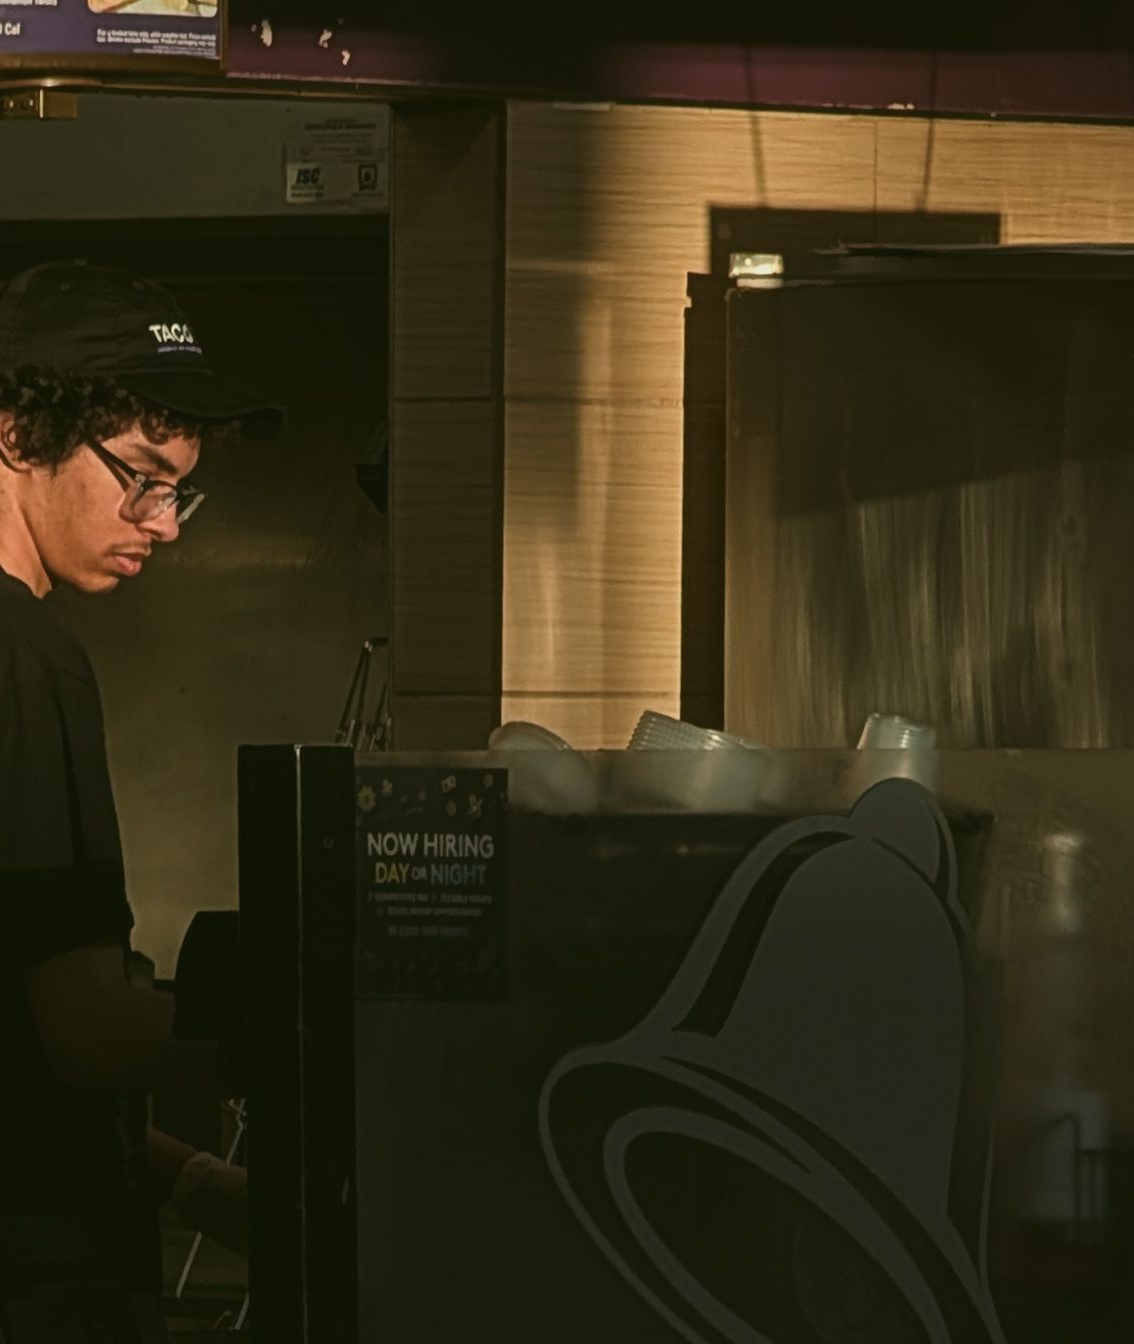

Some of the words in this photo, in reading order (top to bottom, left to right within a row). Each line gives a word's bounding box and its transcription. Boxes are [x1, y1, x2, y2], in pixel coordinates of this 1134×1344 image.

[367, 832, 418, 856] NOW
[423, 833, 495, 859] HIRING
[374, 862, 410, 884] DAY
[411, 866, 427, 880] OR
[430, 863, 487, 886] NIGHT
